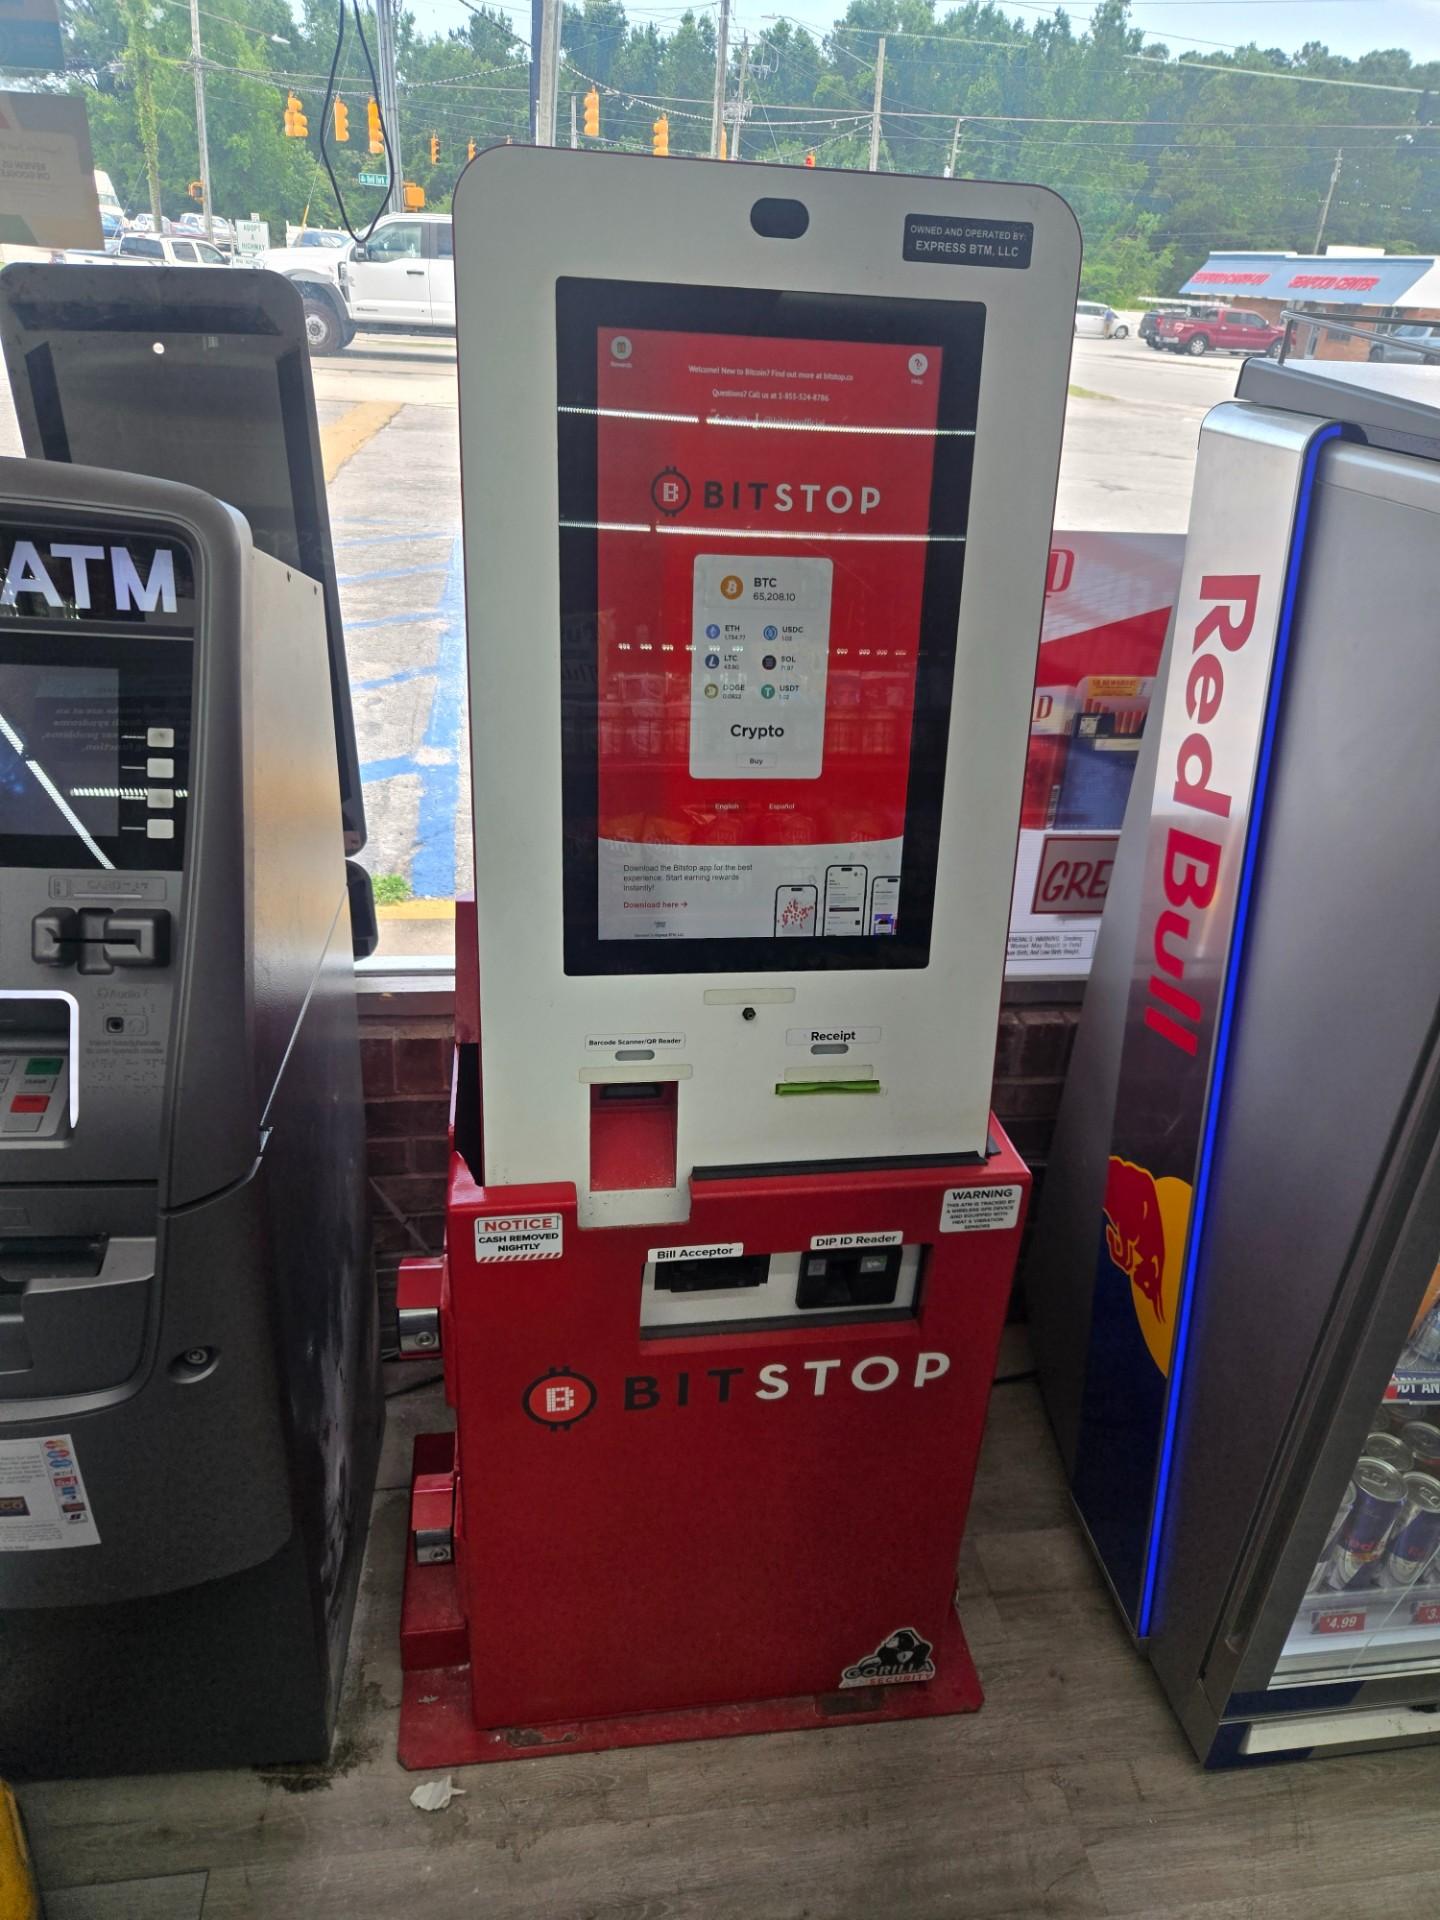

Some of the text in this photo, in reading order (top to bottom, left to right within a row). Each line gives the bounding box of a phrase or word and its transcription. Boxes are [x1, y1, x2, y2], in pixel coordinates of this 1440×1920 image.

[910, 224, 942, 236] OWNED
[944, 227, 963, 237] AND
[965, 228, 1010, 240] OPERATED
[916, 240, 967, 254] EXPRESS
[998, 246, 1019, 257] LLC
[688, 365, 720, 375] Welcome!
[721, 367, 736, 376] New
[736, 368, 744, 376] to
[745, 368, 770, 377] Bitcoin?
[771, 369, 786, 378] Find
[786, 371, 797, 379] out
[798, 372, 814, 380] more
[816, 372, 823, 380] at
[712, 388, 746, 398] Questions?
[748, 390, 760, 399] Call
[762, 392, 769, 400] us
[770, 392, 778, 400] at
[704, 480, 881, 514] BITSTOP
[0, 540, 177, 614] ATM
[754, 578, 777, 588] BTC
[753, 592, 796, 602] 65,208.10
[724, 624, 804, 634] ETH USDC
[780, 684, 800, 692] USDT
[730, 724, 784, 740] Crypto
[750, 758, 764, 766] Buy
[768, 802, 795, 810] Español
[1144, 574, 1261, 1057] Red Bull
[623, 864, 658, 872] Download
[660, 864, 672, 872] the
[673, 864, 698, 873] Bitstop
[714, 864, 723, 872] for
[724, 864, 736, 872] the
[738, 864, 753, 872] best
[666, 874, 683, 882] Start
[684, 874, 710, 882] earning
[623, 901, 661, 909] Download
[618, 1038, 657, 1046] Scanner/QR
[810, 1030, 856, 1042] Receipt
[952, 1188, 1013, 1200] WARNING
[484, 1218, 552, 1232] NOTICE
[478, 1232, 559, 1244] CASH REMOVED
[498, 1243, 541, 1252] NIGHTLY
[656, 1234, 896, 1260] Bill Acceptor DIP ID Reader
[624, 1352, 951, 1411] BITSTOP
[845, 1661, 933, 1680] GORILLA
[868, 1673, 931, 1686] SECURITY
